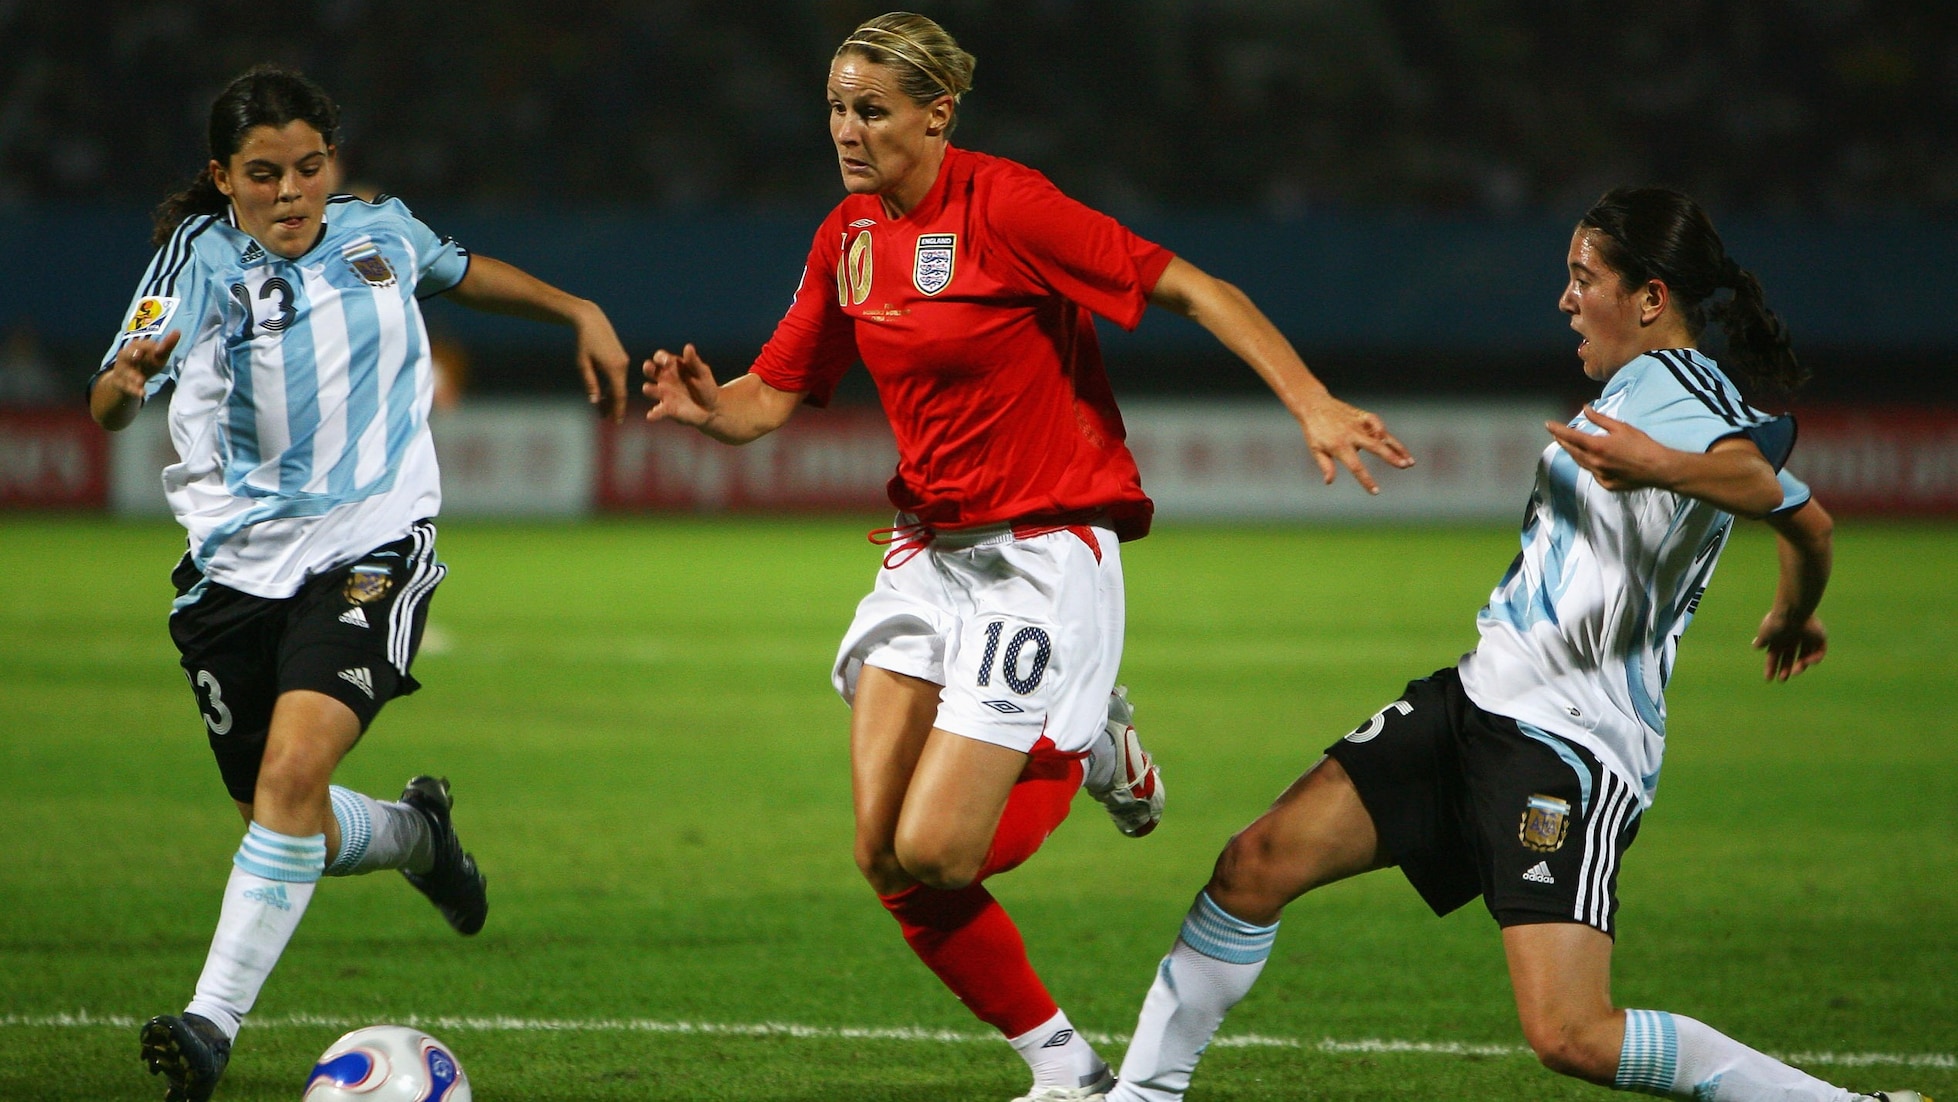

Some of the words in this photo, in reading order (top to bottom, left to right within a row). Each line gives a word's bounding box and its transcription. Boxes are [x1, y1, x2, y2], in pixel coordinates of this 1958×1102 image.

[921, 237, 952, 245] ENGLAND
[229, 277, 299, 342] 13
[976, 621, 1052, 696] 10
[184, 668, 233, 735] 3
[1522, 872, 1555, 884] adidas
